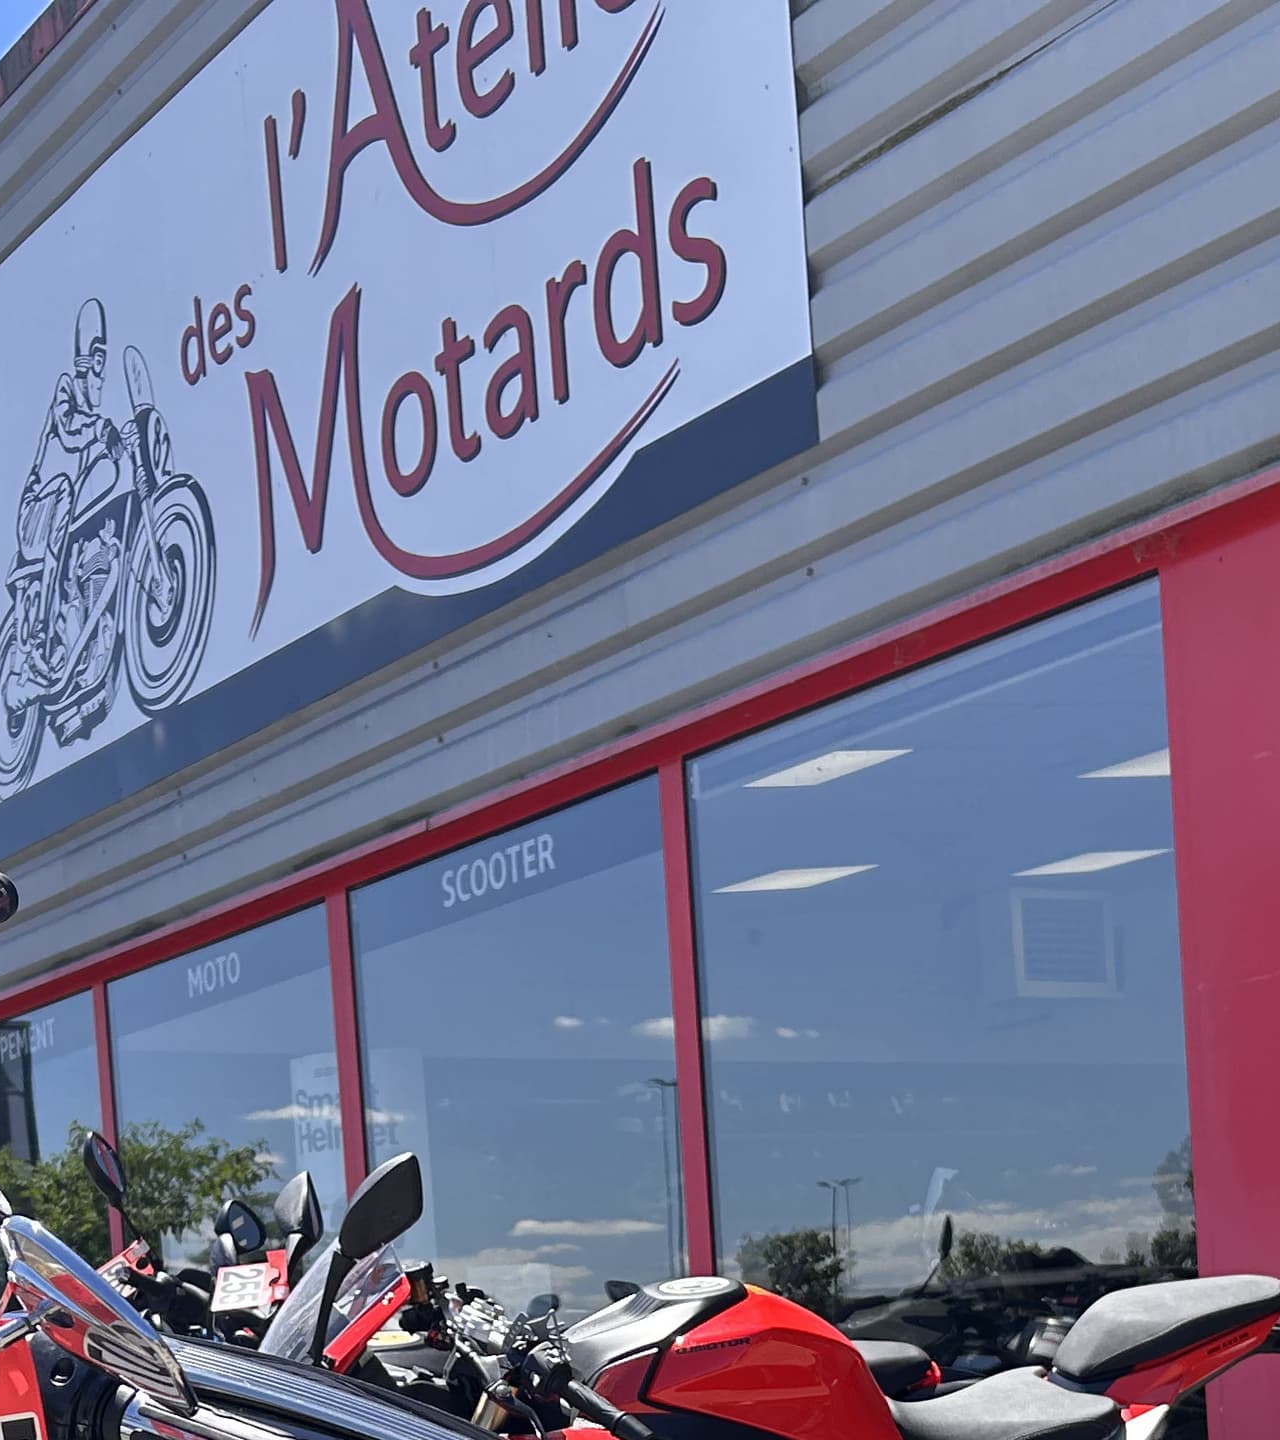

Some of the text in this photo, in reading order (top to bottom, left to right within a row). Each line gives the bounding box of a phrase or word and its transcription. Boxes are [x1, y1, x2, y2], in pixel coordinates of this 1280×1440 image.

[180, 282, 257, 386] des
[244, 157, 728, 641] Motards
[153, 415, 172, 477] 82
[441, 833, 556, 908] SCOOTER
[187, 952, 241, 999] MOTO
